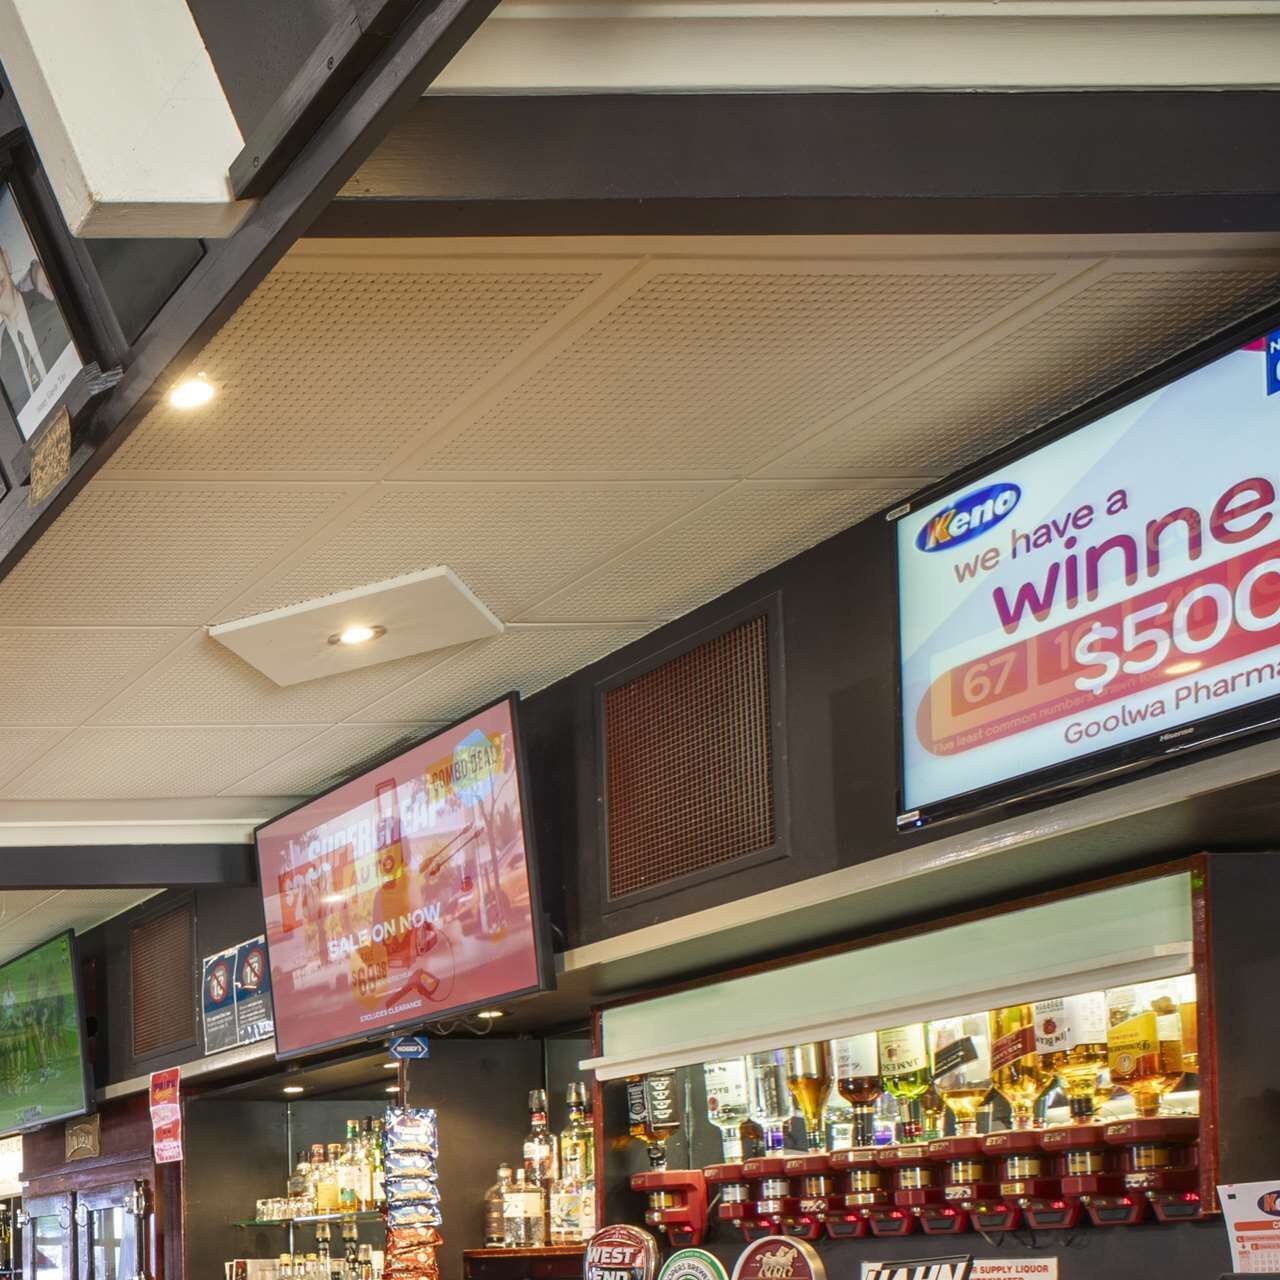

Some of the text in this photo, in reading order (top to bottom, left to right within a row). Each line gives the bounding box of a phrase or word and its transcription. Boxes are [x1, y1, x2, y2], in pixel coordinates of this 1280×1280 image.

[926, 489, 1017, 550] Keno
[955, 489, 1128, 583] we have a
[993, 477, 1280, 636] winne
[961, 651, 1017, 703] 67
[957, 729, 983, 748] least
[986, 711, 1037, 737] common
[1064, 697, 1167, 747] Goolwa
[1159, 727, 1195, 743] Hisense
[471, 745, 497, 774] DEAL
[327, 902, 441, 960] SALE ON NOW
[388, 1000, 423, 1015] CLEARANCE
[588, 1247, 635, 1264] WEST
[980, 1264, 1049, 1274] SUPPLY LIQUOR
